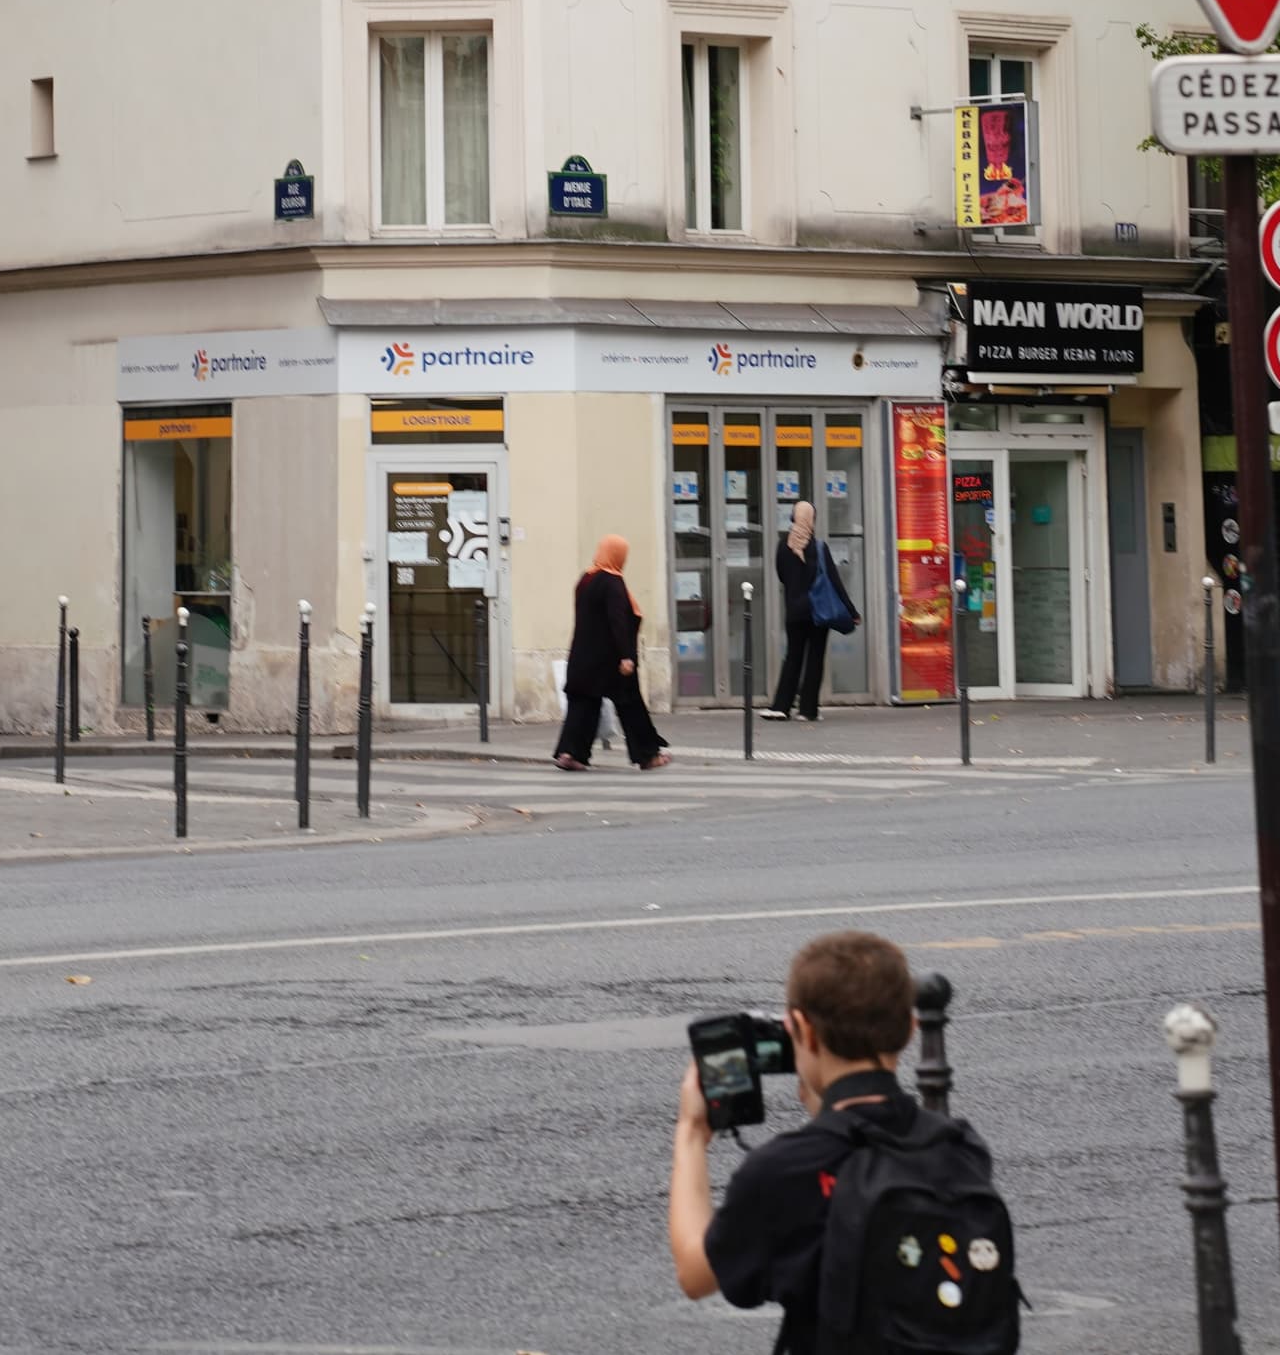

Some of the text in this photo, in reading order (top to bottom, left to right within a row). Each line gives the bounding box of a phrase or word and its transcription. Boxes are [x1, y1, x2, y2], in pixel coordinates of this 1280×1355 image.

[1179, 69, 1279, 97] CÉDEZ
[961, 110, 974, 223] KEBAB PIZZA
[563, 182, 592, 193] AVENUE
[973, 300, 1144, 331] NAAN WORLD
[211, 350, 266, 379] partnaire
[422, 344, 534, 373] partnaire
[737, 347, 817, 373] partnaire
[978, 345, 1135, 363] PIZZA BURGER KEBAB TACOS
[402, 415, 471, 426] LOGISTIQUE
[955, 477, 982, 487] PIZZA
